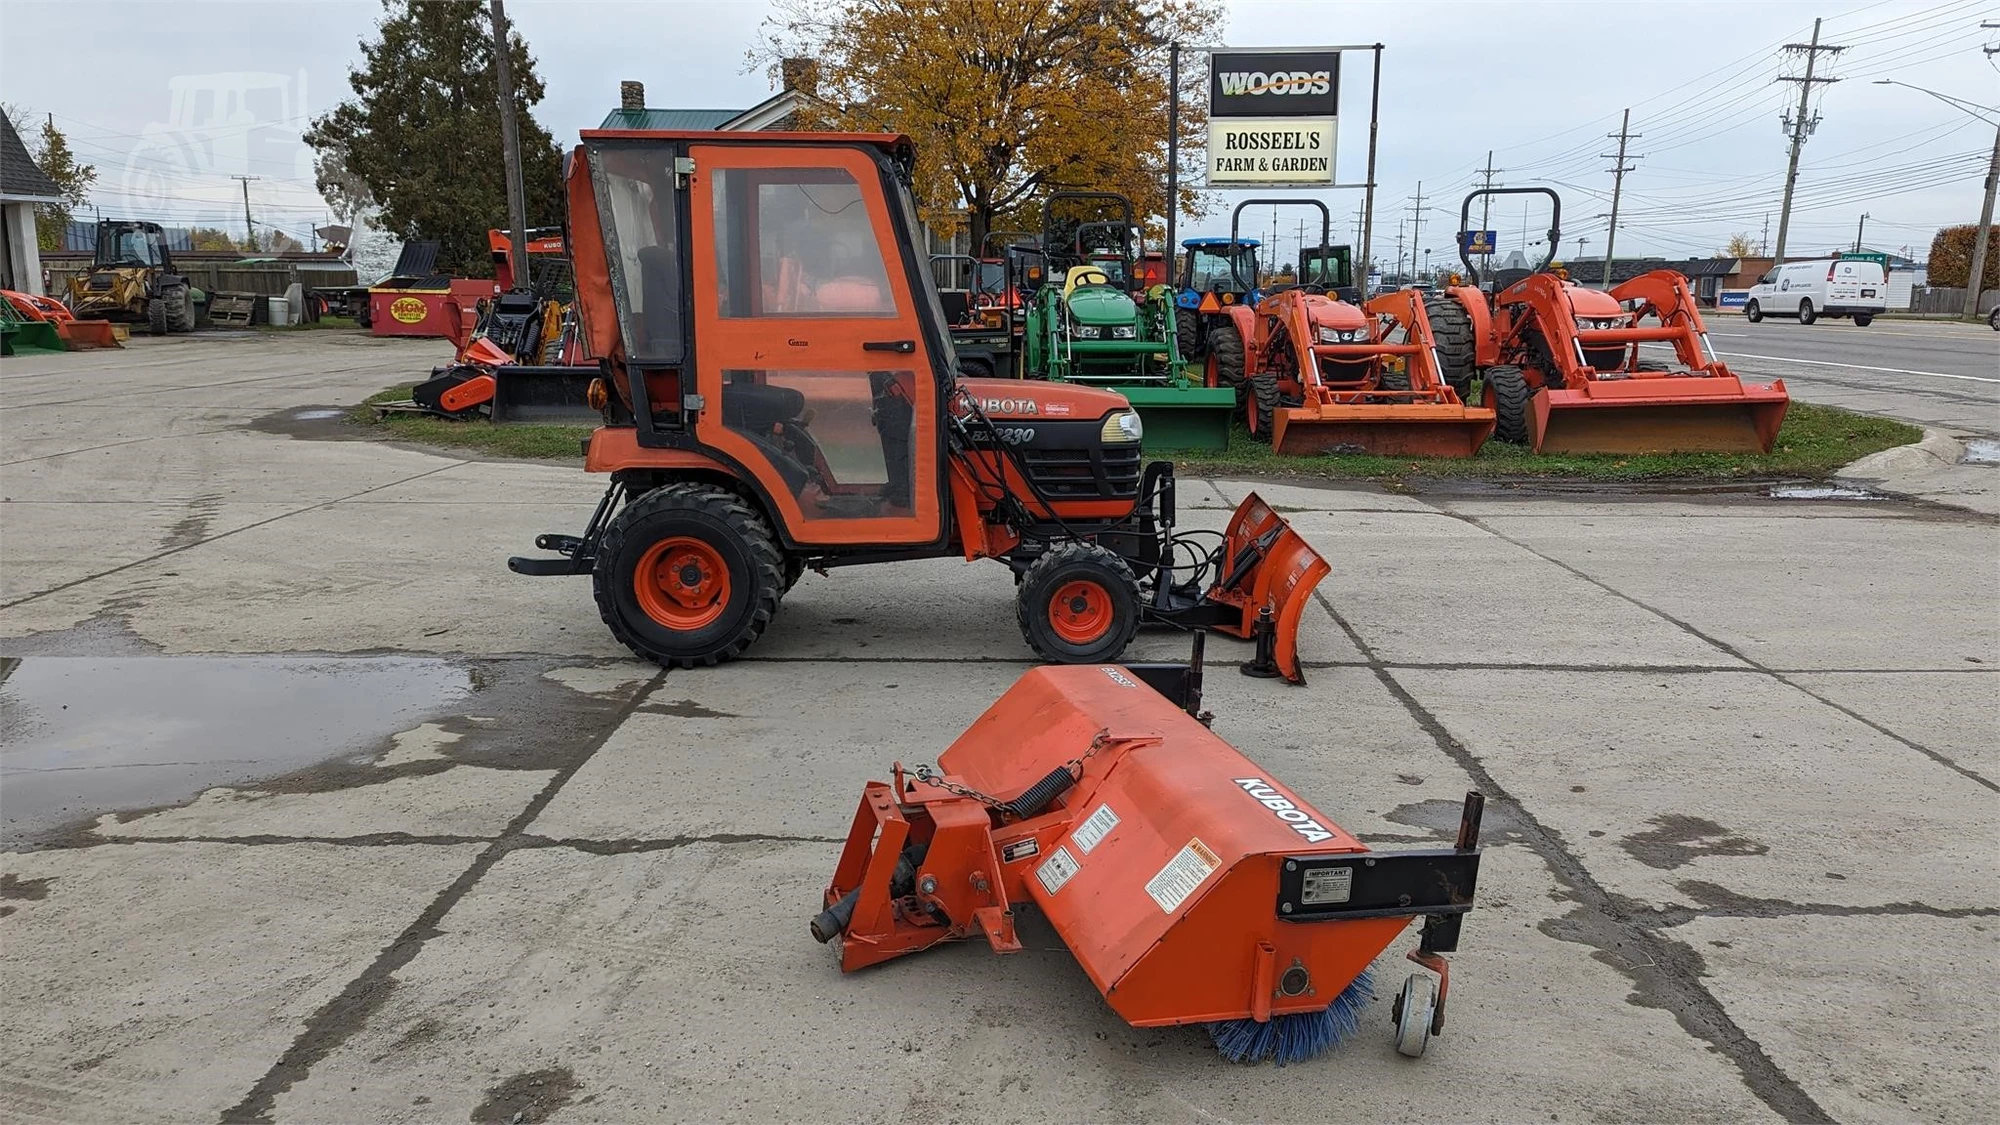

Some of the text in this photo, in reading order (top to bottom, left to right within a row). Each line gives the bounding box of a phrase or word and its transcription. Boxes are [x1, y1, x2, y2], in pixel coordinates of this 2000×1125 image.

[1219, 71, 1331, 96] WOODS
[1225, 131, 1320, 150] ROSSEEL'S
[1215, 157, 1328, 172] FARM & GARDEN
[393, 302, 425, 313] MGM
[959, 396, 1039, 414] KUBOTA
[1231, 778, 1336, 843] KUBOTA
[1194, 844, 1217, 867] WARNING
